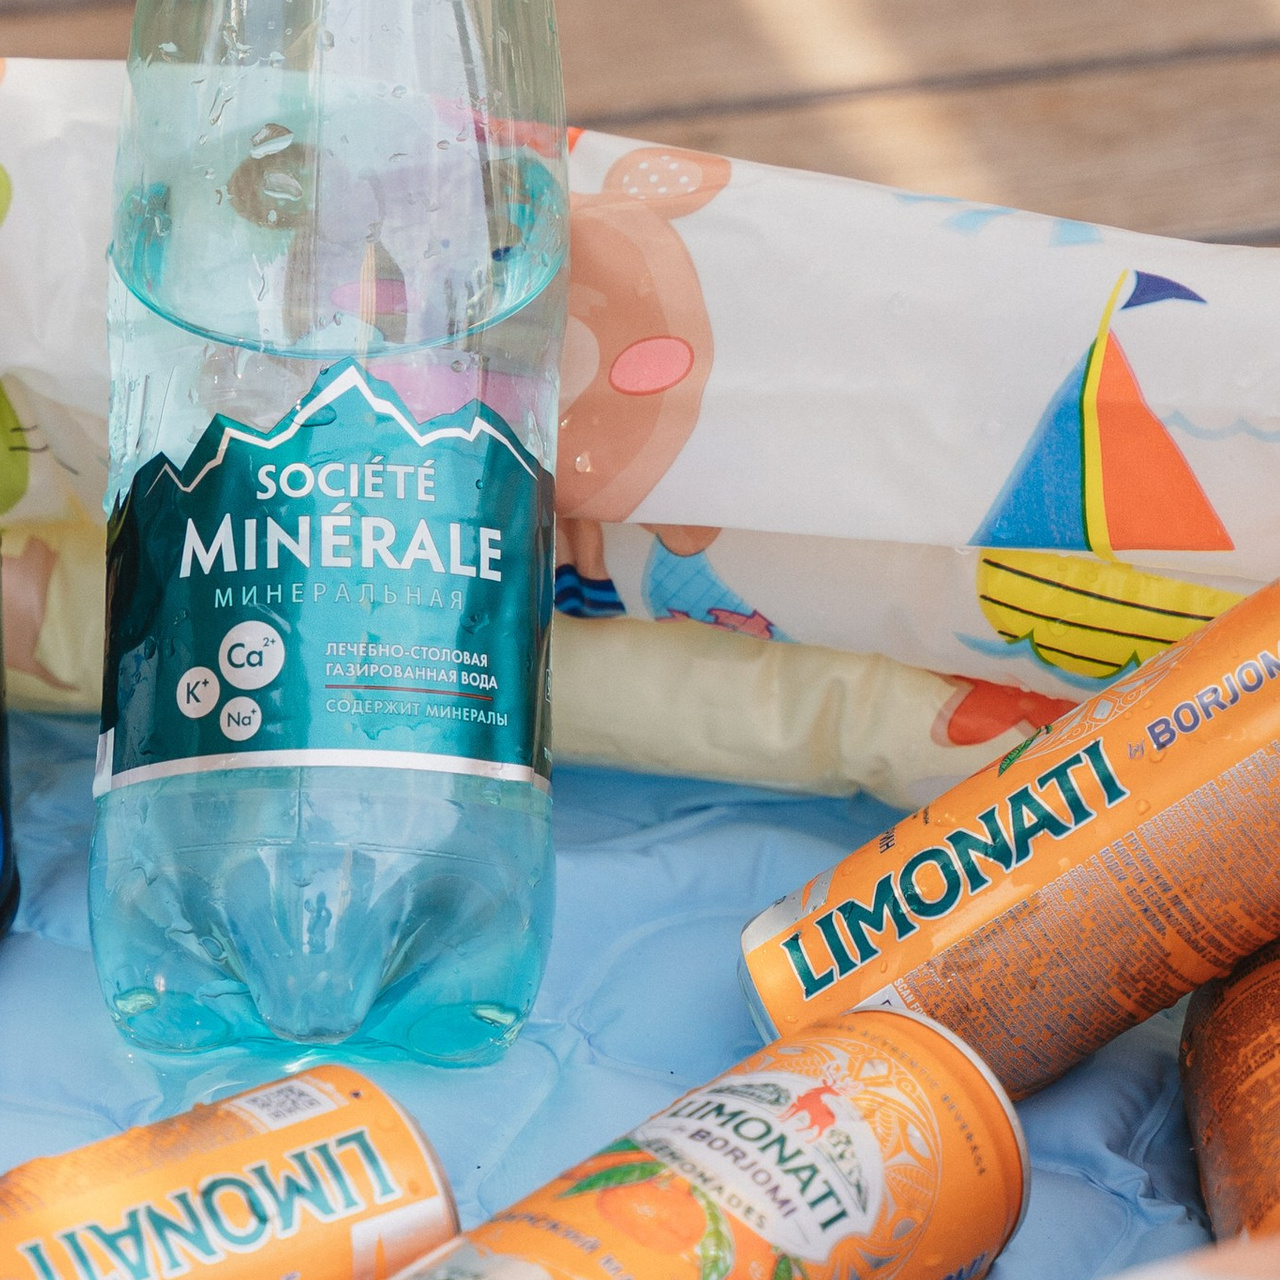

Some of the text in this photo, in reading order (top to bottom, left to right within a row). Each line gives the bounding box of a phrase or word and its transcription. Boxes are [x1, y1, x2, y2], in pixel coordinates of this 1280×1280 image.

[255, 455, 436, 503] SOCIÉTÉ
[179, 502, 503, 582] MINÉRALE
[214, 583, 463, 611] МИНЕРАЛЬНАЯ
[324, 641, 489, 668] ЛЕЧЕБНО-СТОЛОВАЯ
[325, 662, 498, 691] ГАЗИРОВАННАЯ ВОДА
[325, 698, 509, 727] СОДЕРЖИТ МИНЕРАЛЫ
[780, 737, 1131, 1001] LIMONATI
[1145, 639, 1280, 752] BORJOM
[892, 977, 915, 1004] SCAN
[668, 1099, 850, 1232] LIMONATI
[687, 1127, 799, 1218] BORJOMI
